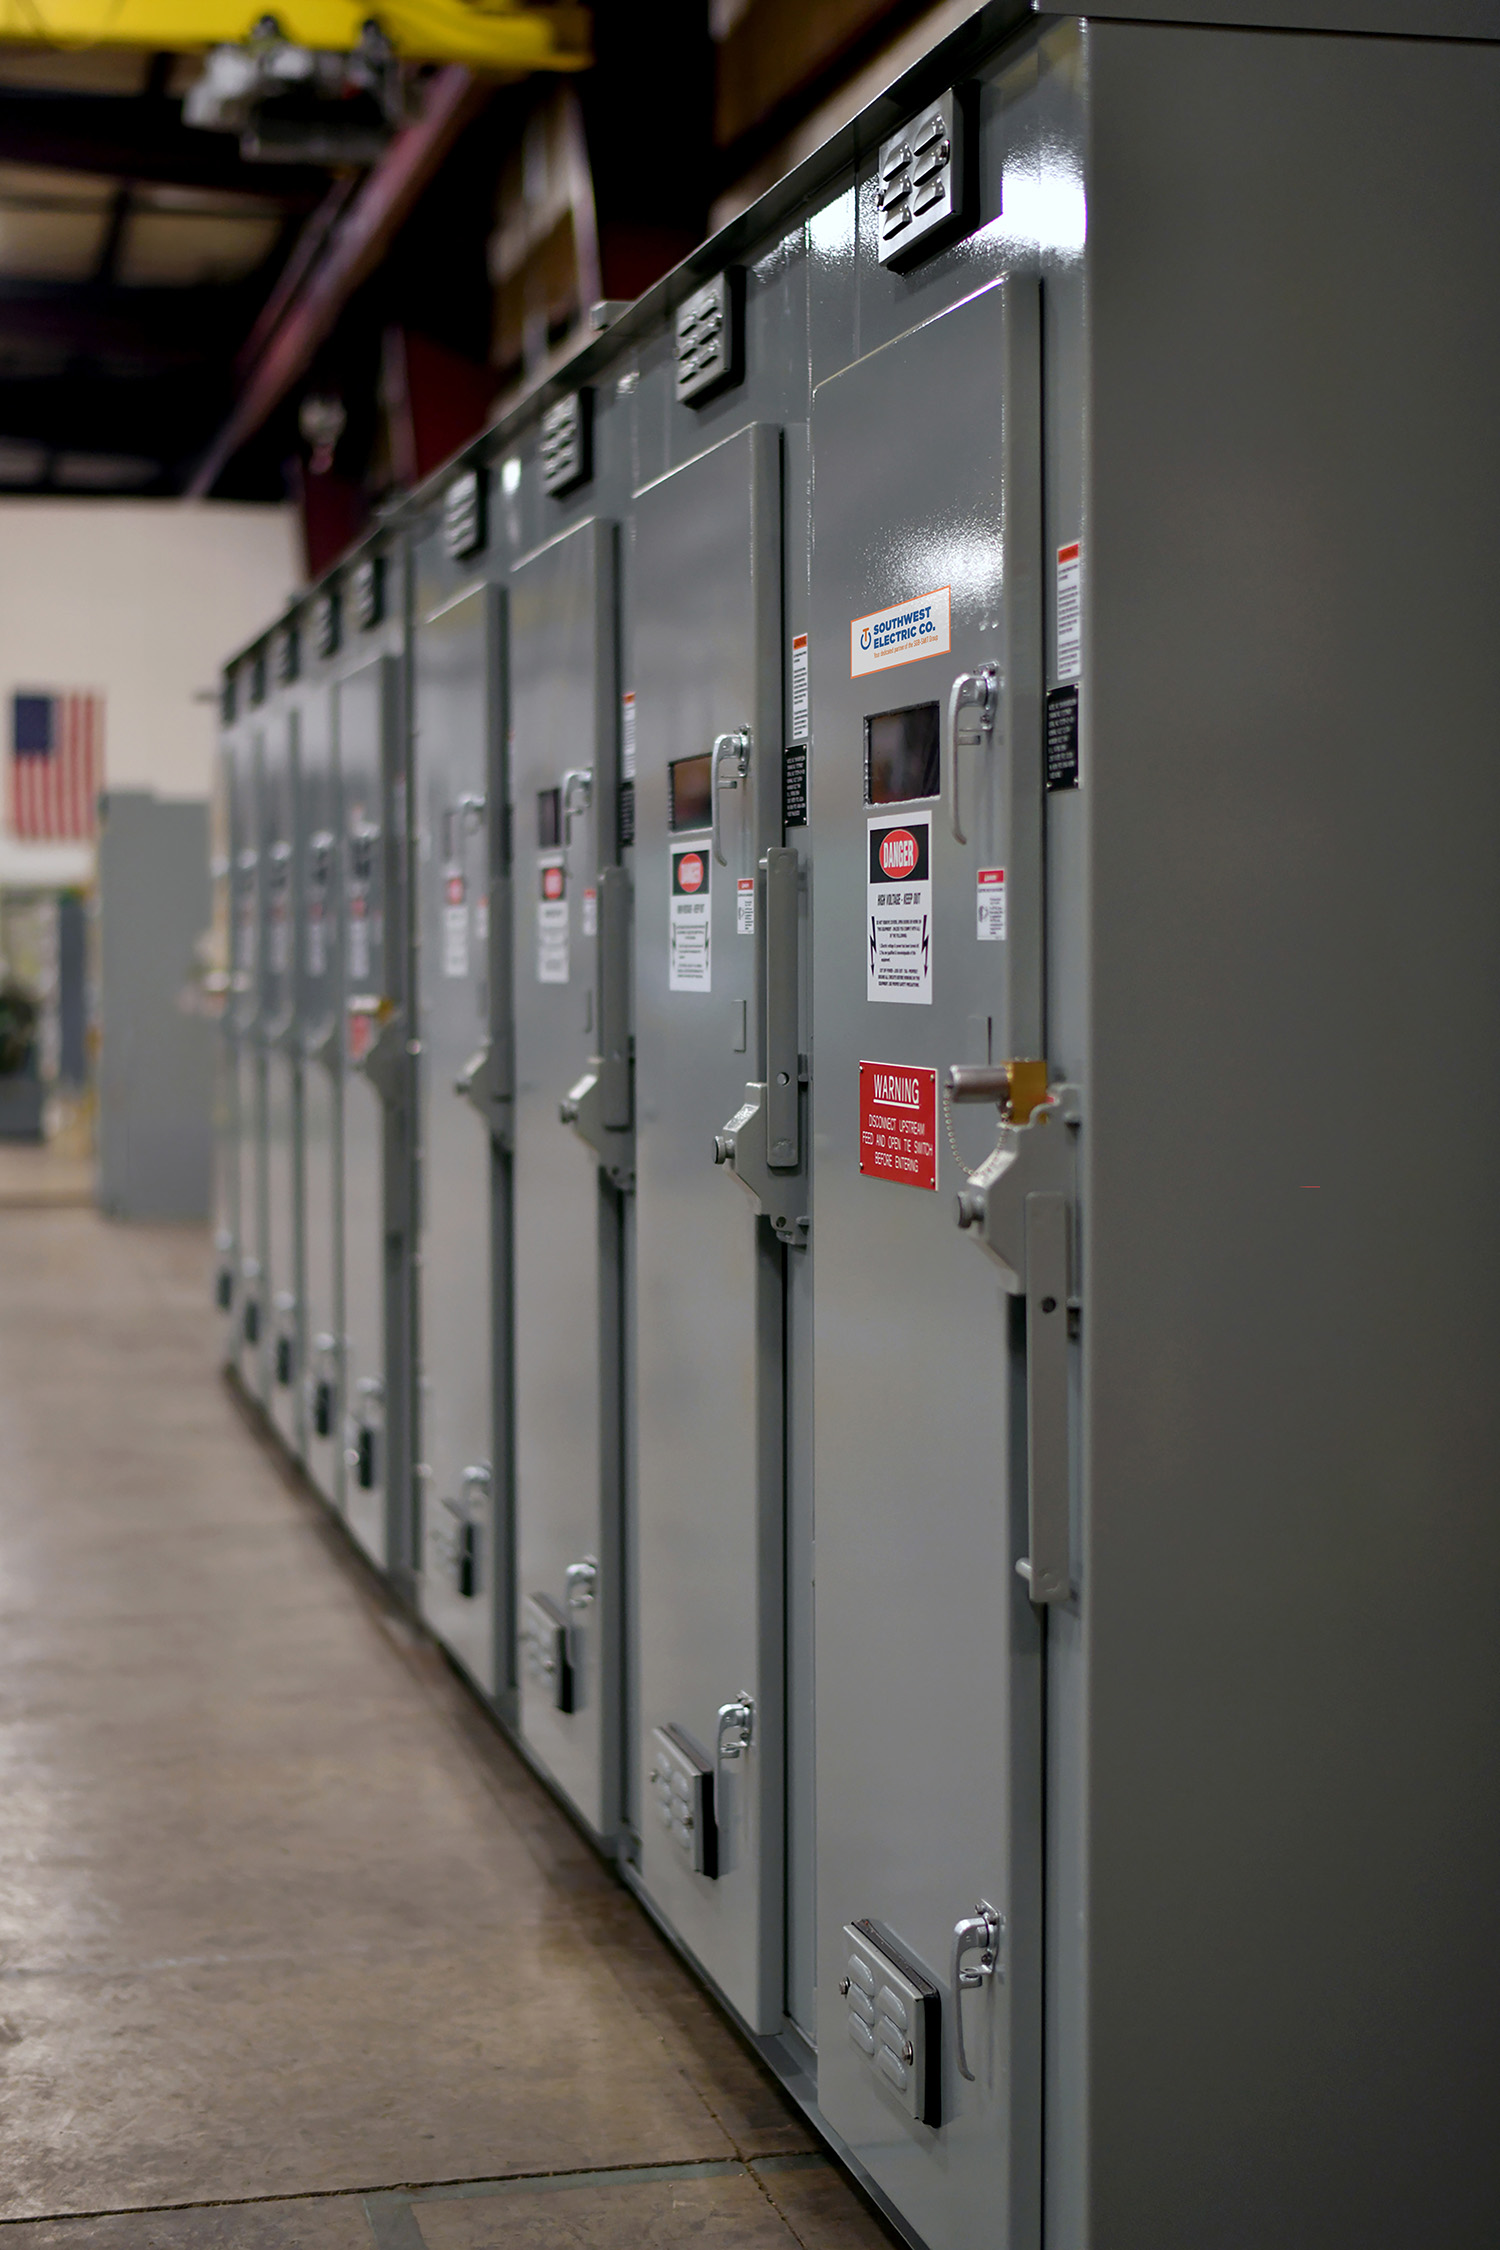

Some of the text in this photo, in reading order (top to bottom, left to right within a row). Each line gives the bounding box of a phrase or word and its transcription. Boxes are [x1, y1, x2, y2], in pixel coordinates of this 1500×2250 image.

[873, 606, 931, 636] SOUTHWEST
[873, 621, 936, 649] ELECTRIC CO.
[883, 840, 913, 868] DANGER
[873, 1074, 919, 1103] WARNING
[869, 1114, 925, 1135] DISCONNECT UPSTREAM
[862, 1131, 933, 1156] FEED AND OPEN TIE SWITCH
[875, 1151, 918, 1172] BEFORE ENTERING
